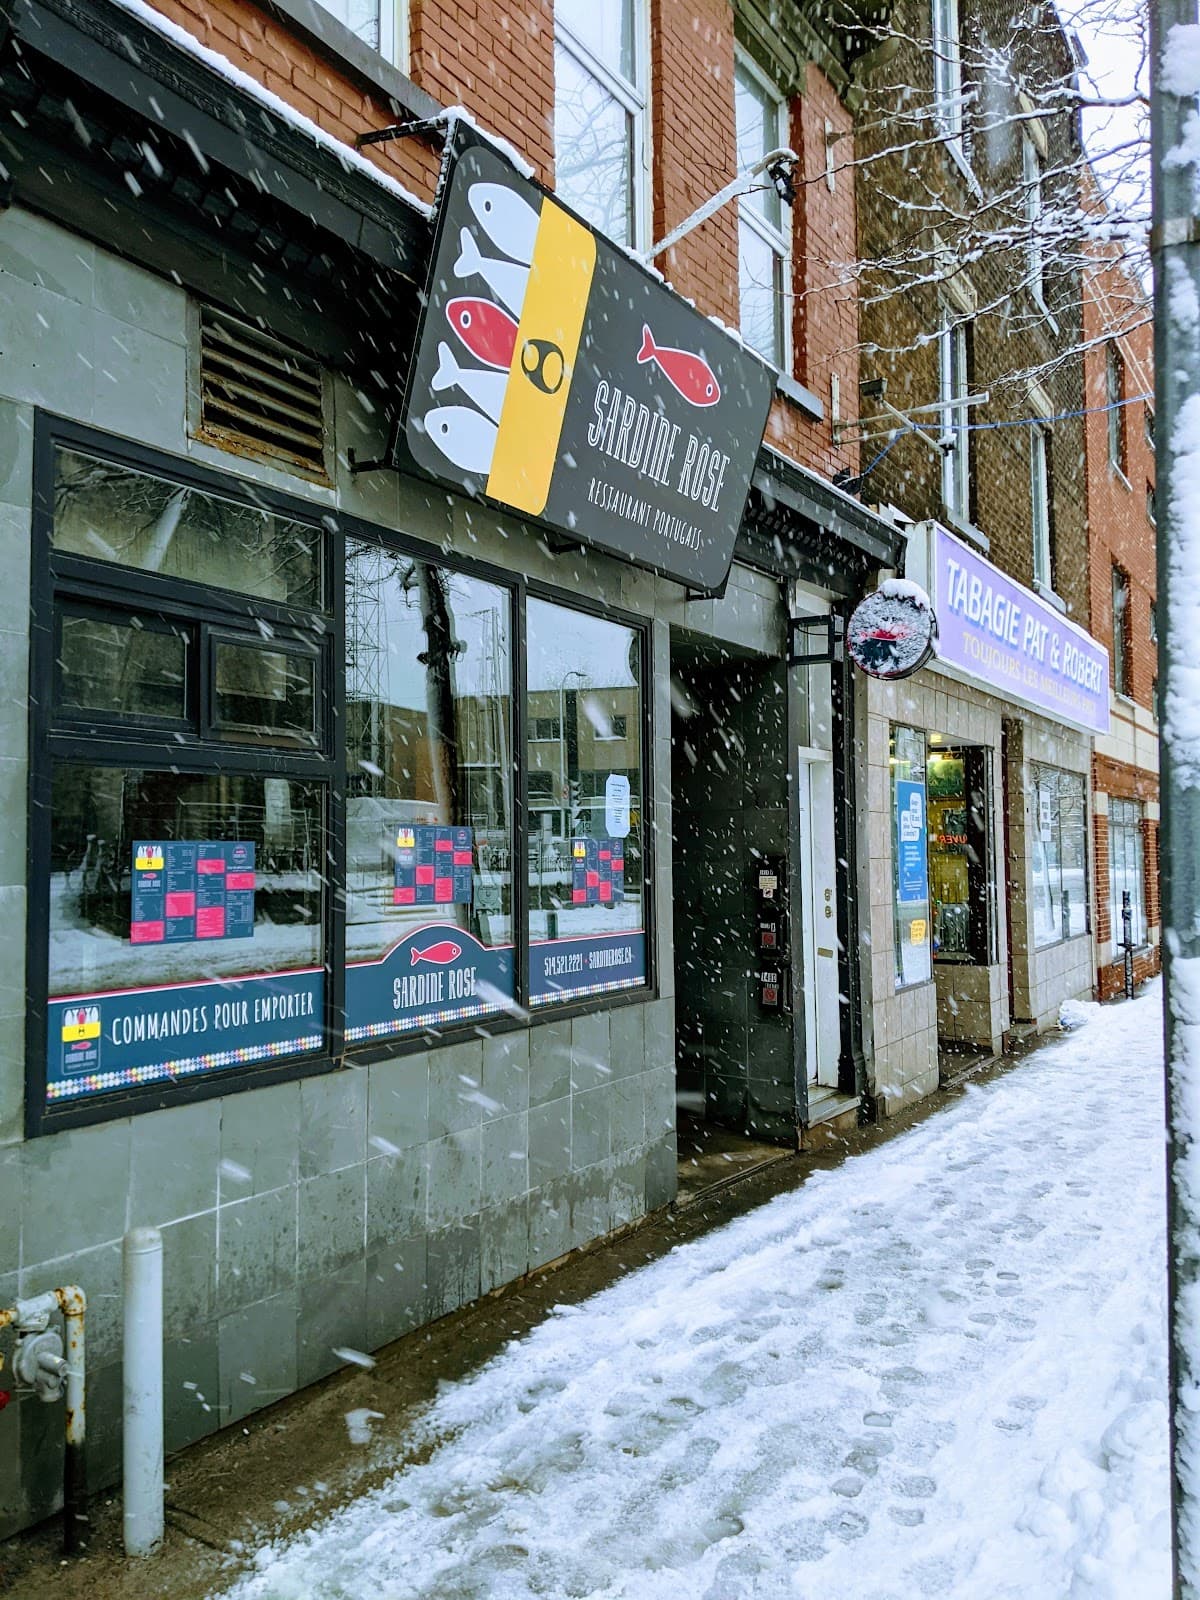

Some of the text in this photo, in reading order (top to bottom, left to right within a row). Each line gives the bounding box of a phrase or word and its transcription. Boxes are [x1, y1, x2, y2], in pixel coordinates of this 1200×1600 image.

[587, 379, 731, 513] SARDINE ROSE
[587, 477, 702, 551] RESTAURANT PORTUGAIS
[947, 557, 1104, 695] TABAGIE PAT & ROBERT
[962, 631, 1021, 680] TOUJOURS
[112, 991, 314, 1046] COMMANDES POUR EMPORTER
[392, 966, 477, 1010] SARDINE ROSE
